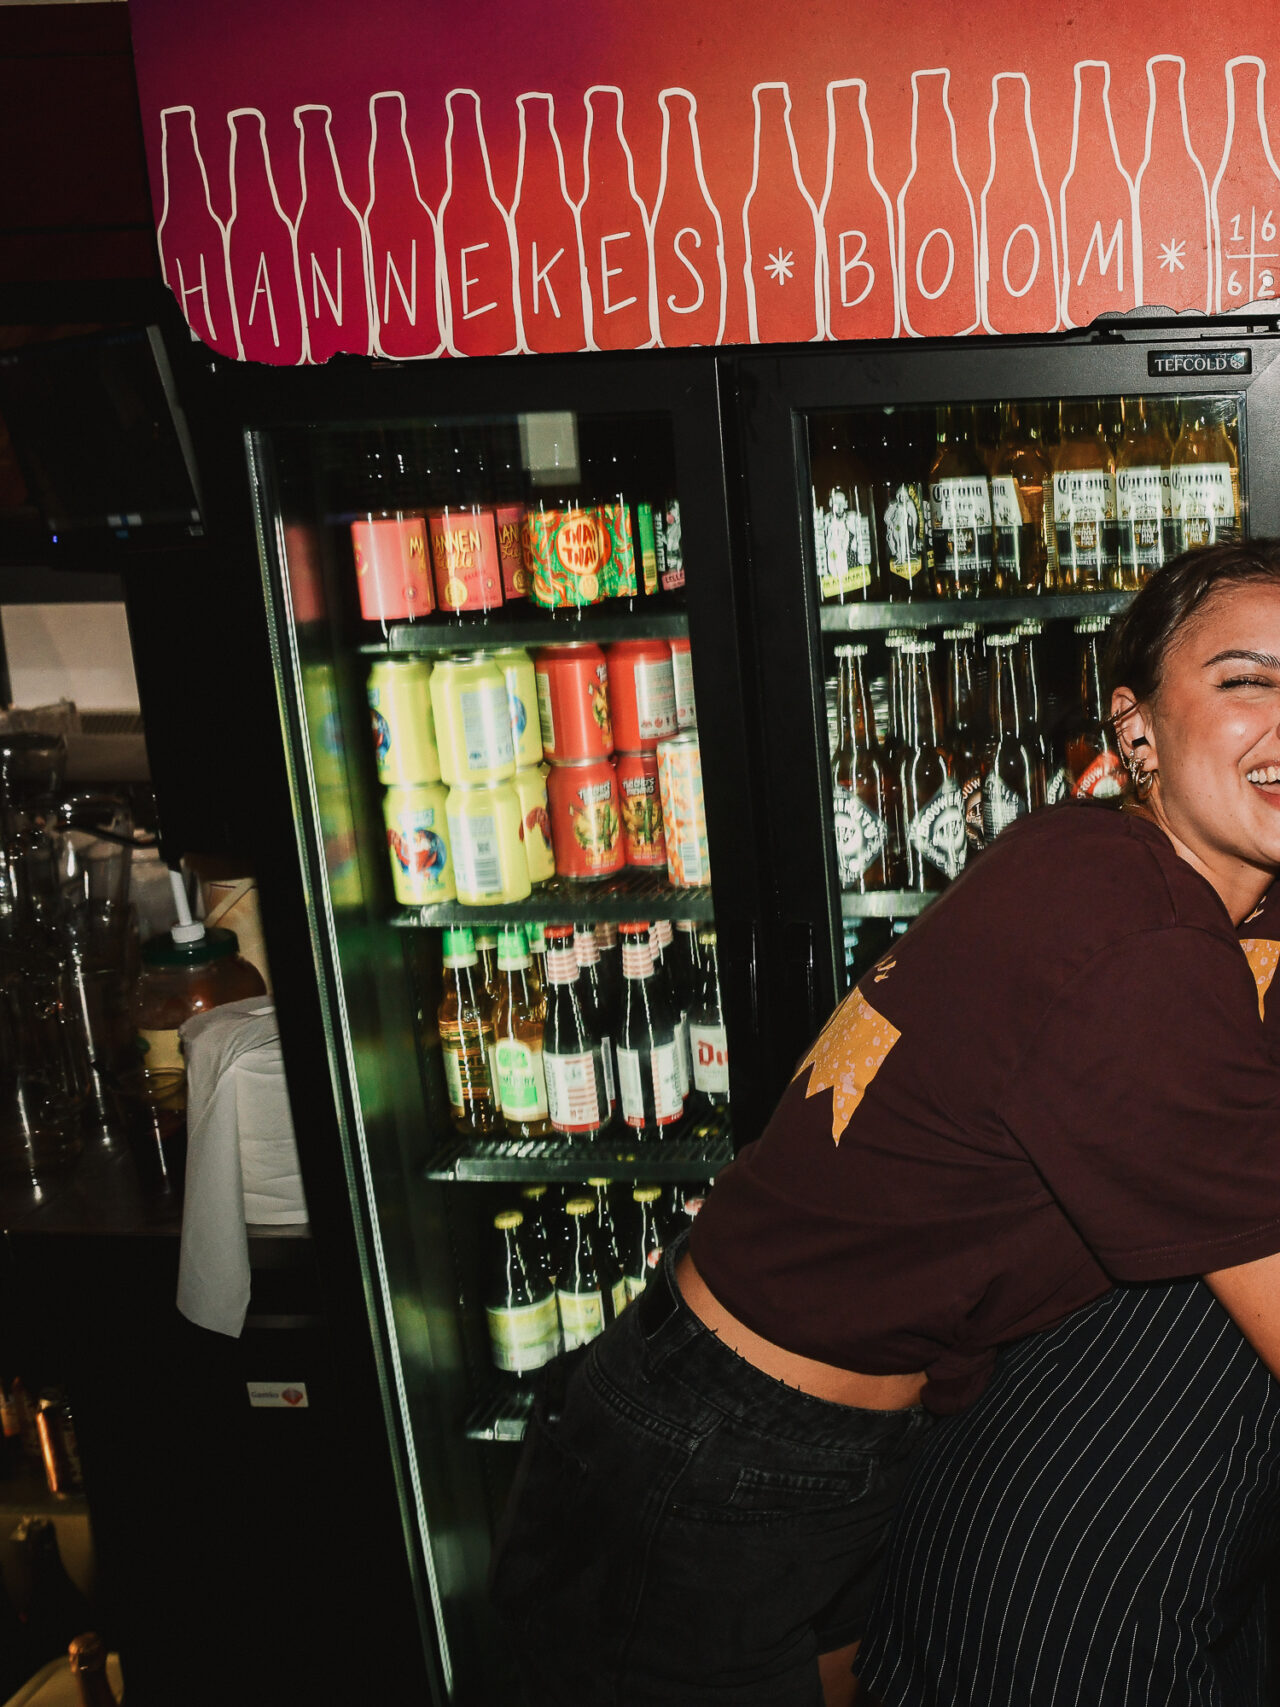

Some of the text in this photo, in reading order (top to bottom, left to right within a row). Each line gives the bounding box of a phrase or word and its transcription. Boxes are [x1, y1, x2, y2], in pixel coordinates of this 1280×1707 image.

[176, 218, 1123, 347] HANNEKES BOOM
[1154, 357, 1228, 371] TEFCOLD
[1057, 476, 1110, 494] Corona
[1118, 473, 1170, 492] Corona
[1171, 470, 1222, 489] Corona
[932, 484, 983, 503] Corona
[945, 500, 973, 511] Etra
[698, 1040, 728, 1066] Du
